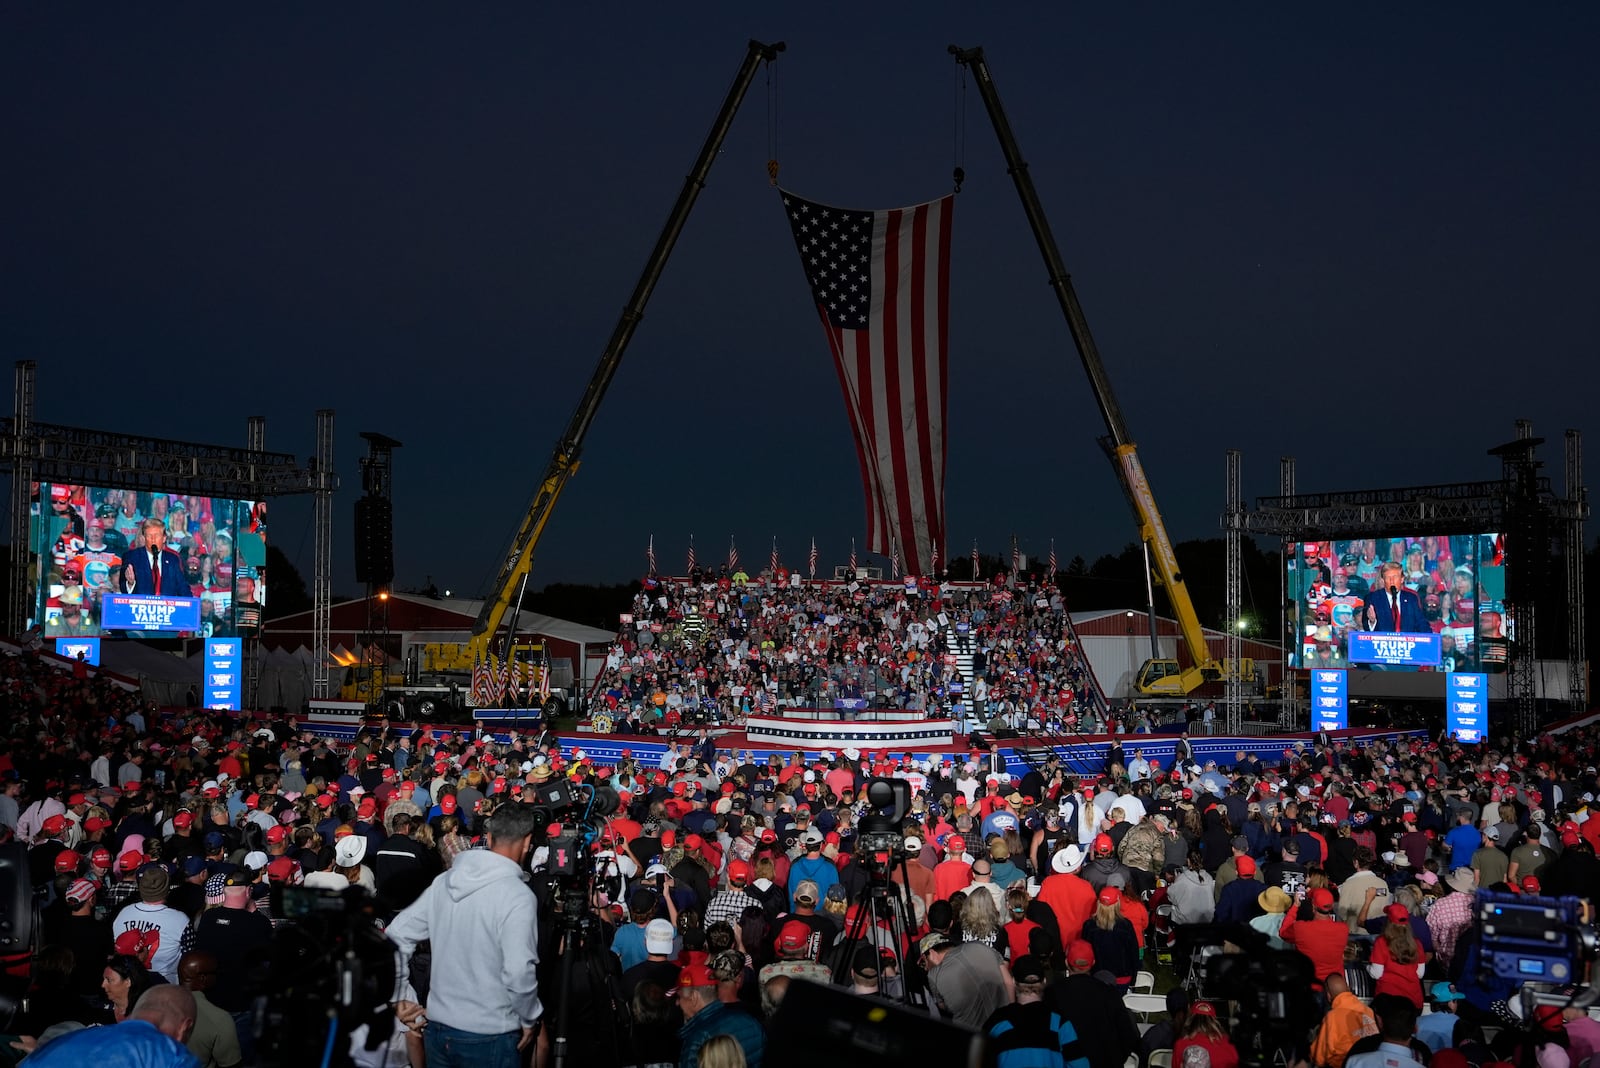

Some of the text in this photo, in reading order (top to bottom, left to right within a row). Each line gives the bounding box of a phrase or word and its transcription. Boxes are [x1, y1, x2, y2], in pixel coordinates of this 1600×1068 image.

[130, 604, 176, 615] TRUMP
[134, 614, 170, 622] VANCE
[1372, 640, 1415, 650] TRUMP
[1377, 649, 1411, 657] VANCE
[813, 931, 821, 953] TRUMP
